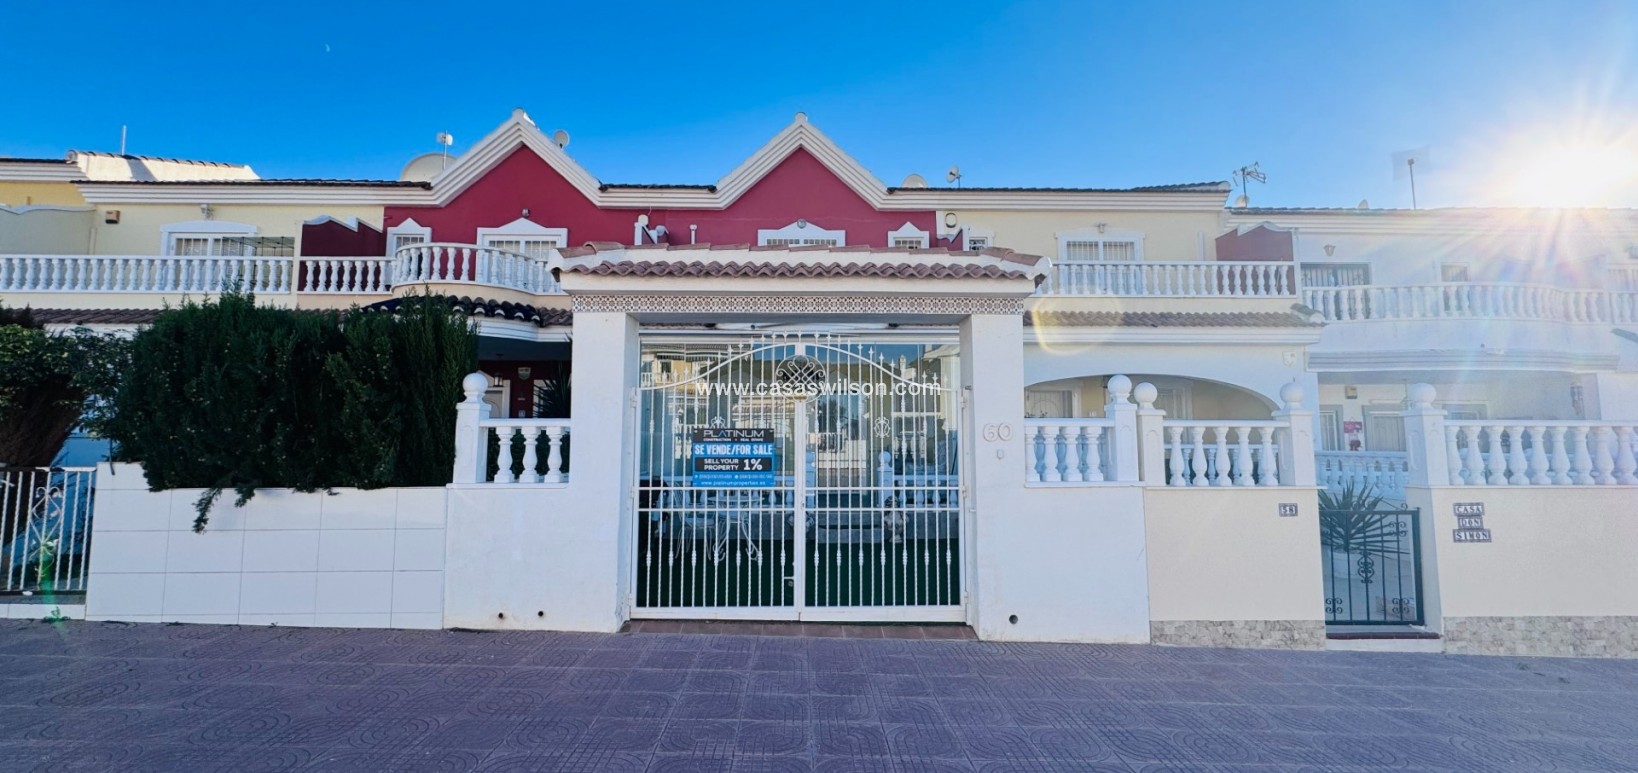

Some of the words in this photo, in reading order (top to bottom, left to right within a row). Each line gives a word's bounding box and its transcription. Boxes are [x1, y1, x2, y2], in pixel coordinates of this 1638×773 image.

[703, 429, 764, 437] PLATINUM
[983, 422, 1014, 442] 60
[694, 444, 704, 455] SE
[706, 444, 751, 455] VENDE/FOR
[752, 444, 773, 455] SALE
[743, 458, 763, 471] 1%
[1456, 505, 1483, 514] CASA
[1460, 518, 1480, 527] DON
[1455, 531, 1489, 540] SIMON
